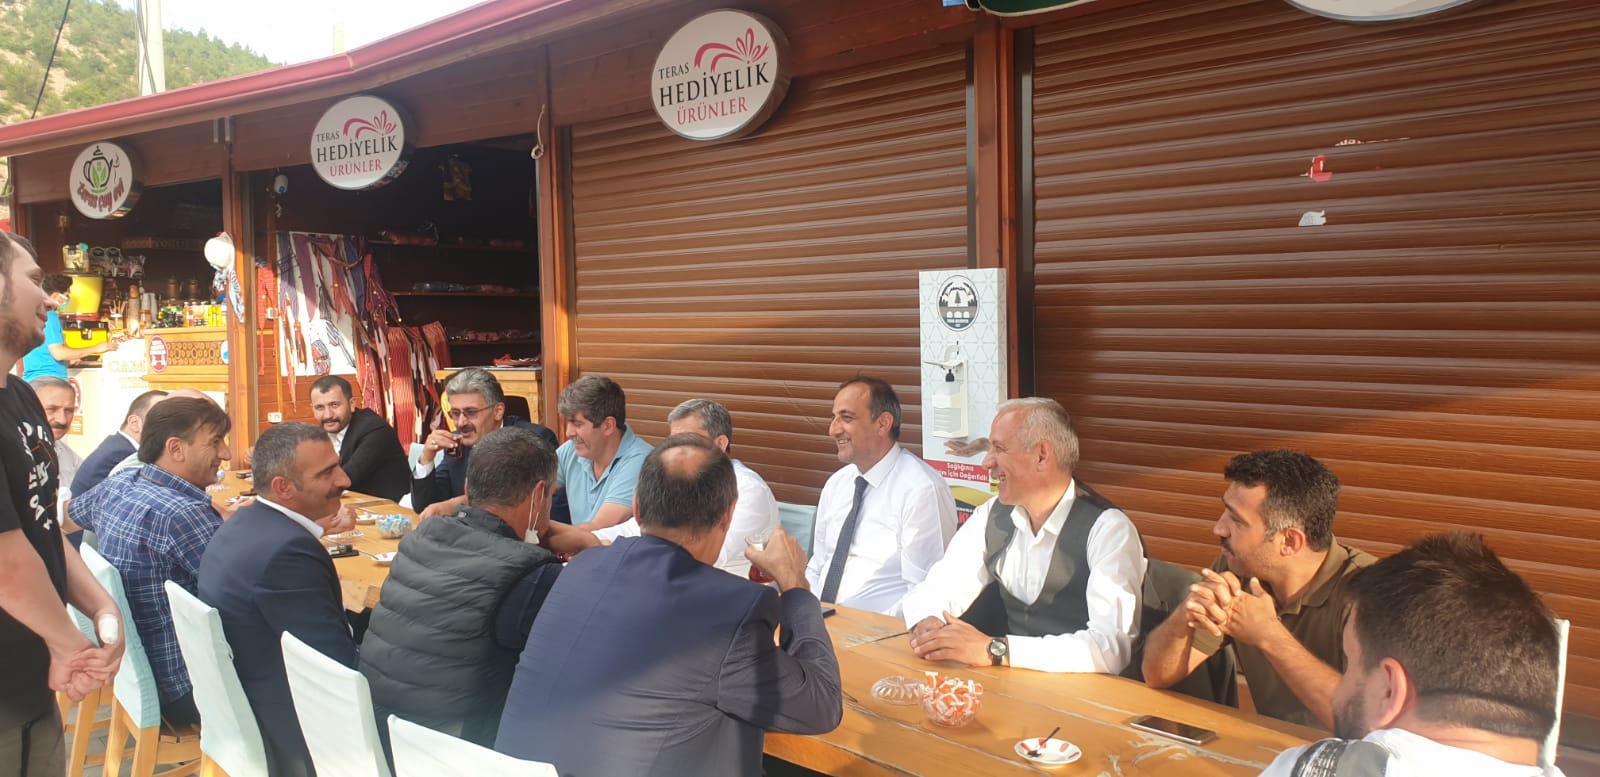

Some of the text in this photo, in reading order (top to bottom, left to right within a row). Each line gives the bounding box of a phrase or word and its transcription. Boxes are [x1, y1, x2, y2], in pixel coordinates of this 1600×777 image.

[658, 63, 689, 80] TERAS
[660, 60, 769, 107] HEDİYELİK
[677, 97, 748, 125] ÜRÜNLER
[316, 130, 340, 143] TERAS
[317, 132, 398, 163] HEDİYELİK
[330, 159, 382, 177] ÜRÜNLER
